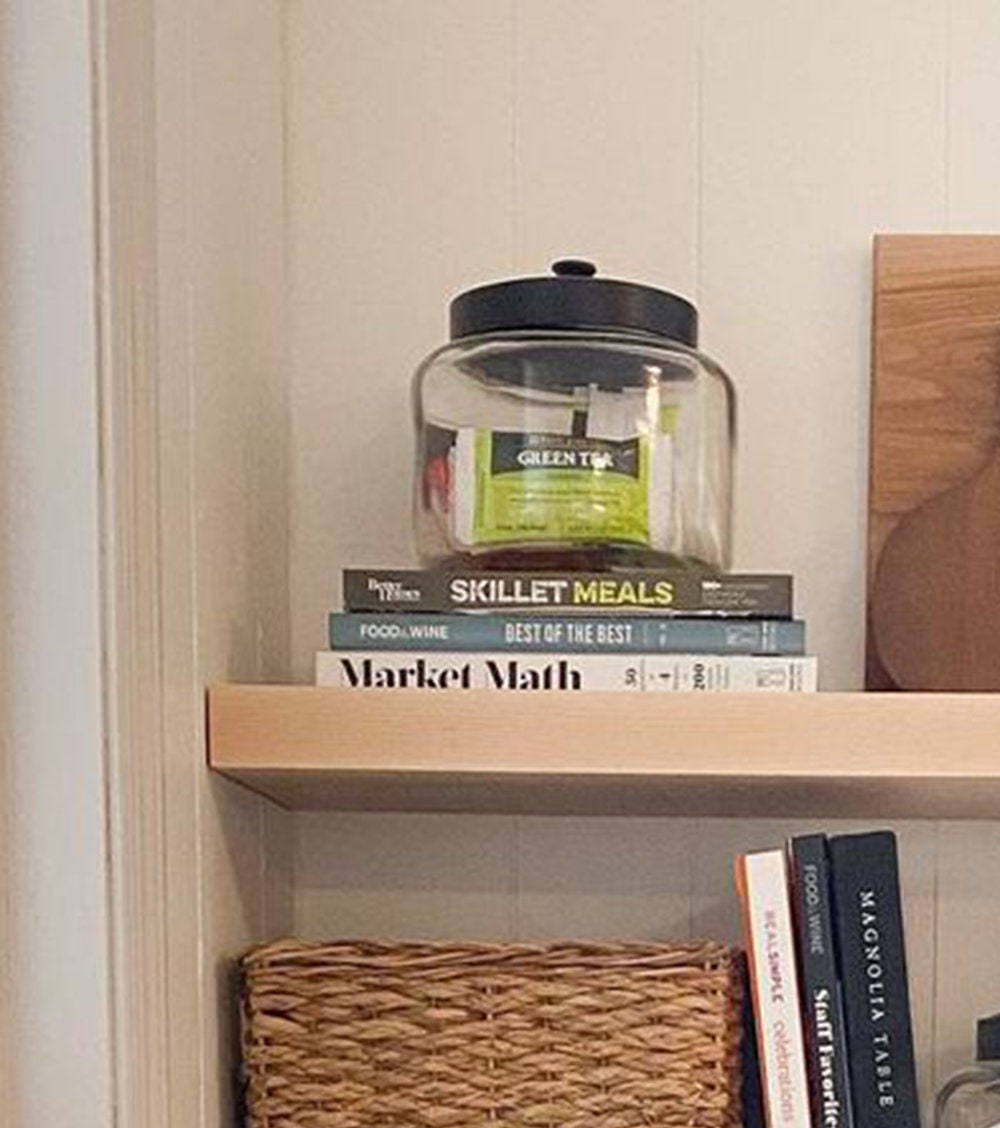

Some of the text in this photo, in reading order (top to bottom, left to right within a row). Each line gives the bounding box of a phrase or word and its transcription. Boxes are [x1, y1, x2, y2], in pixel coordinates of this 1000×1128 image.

[517, 450, 576, 466] GREEN
[450, 579, 568, 602] SKILLET
[573, 580, 674, 604] MEALS
[505, 623, 541, 643] BEST
[544, 623, 564, 643] OF
[567, 624, 593, 643] THE
[597, 624, 633, 643] BEST
[341, 658, 582, 690] Market Math
[693, 663, 706, 690] 200
[859, 890, 895, 1107] MAGNOLIA TABLE
[814, 988, 834, 1042] Staff
[773, 1021, 795, 1122] celebrations
